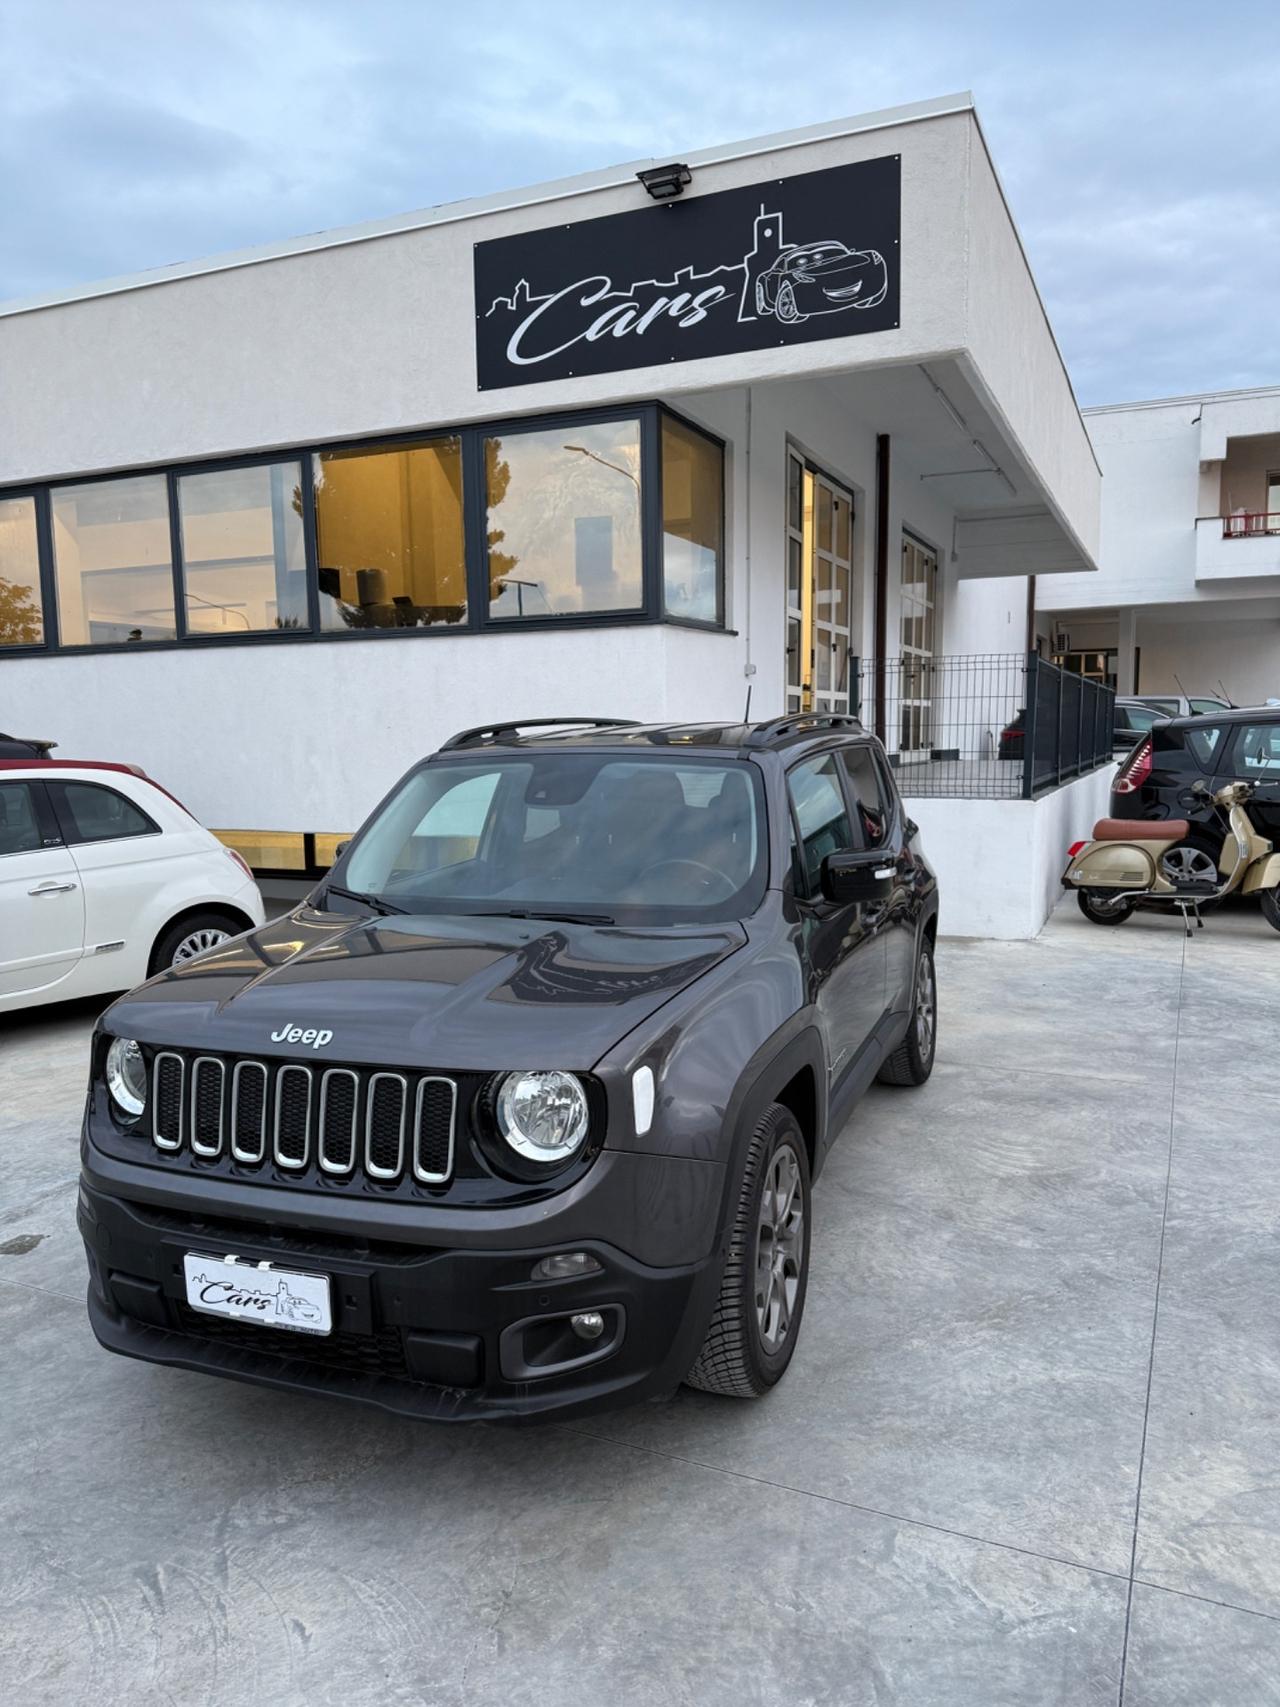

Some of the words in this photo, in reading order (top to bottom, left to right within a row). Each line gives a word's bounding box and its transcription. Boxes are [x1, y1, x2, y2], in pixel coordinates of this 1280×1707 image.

[506, 276, 735, 365] Cars
[271, 1023, 333, 1050] Jeep
[200, 1281, 272, 1310] Cars
